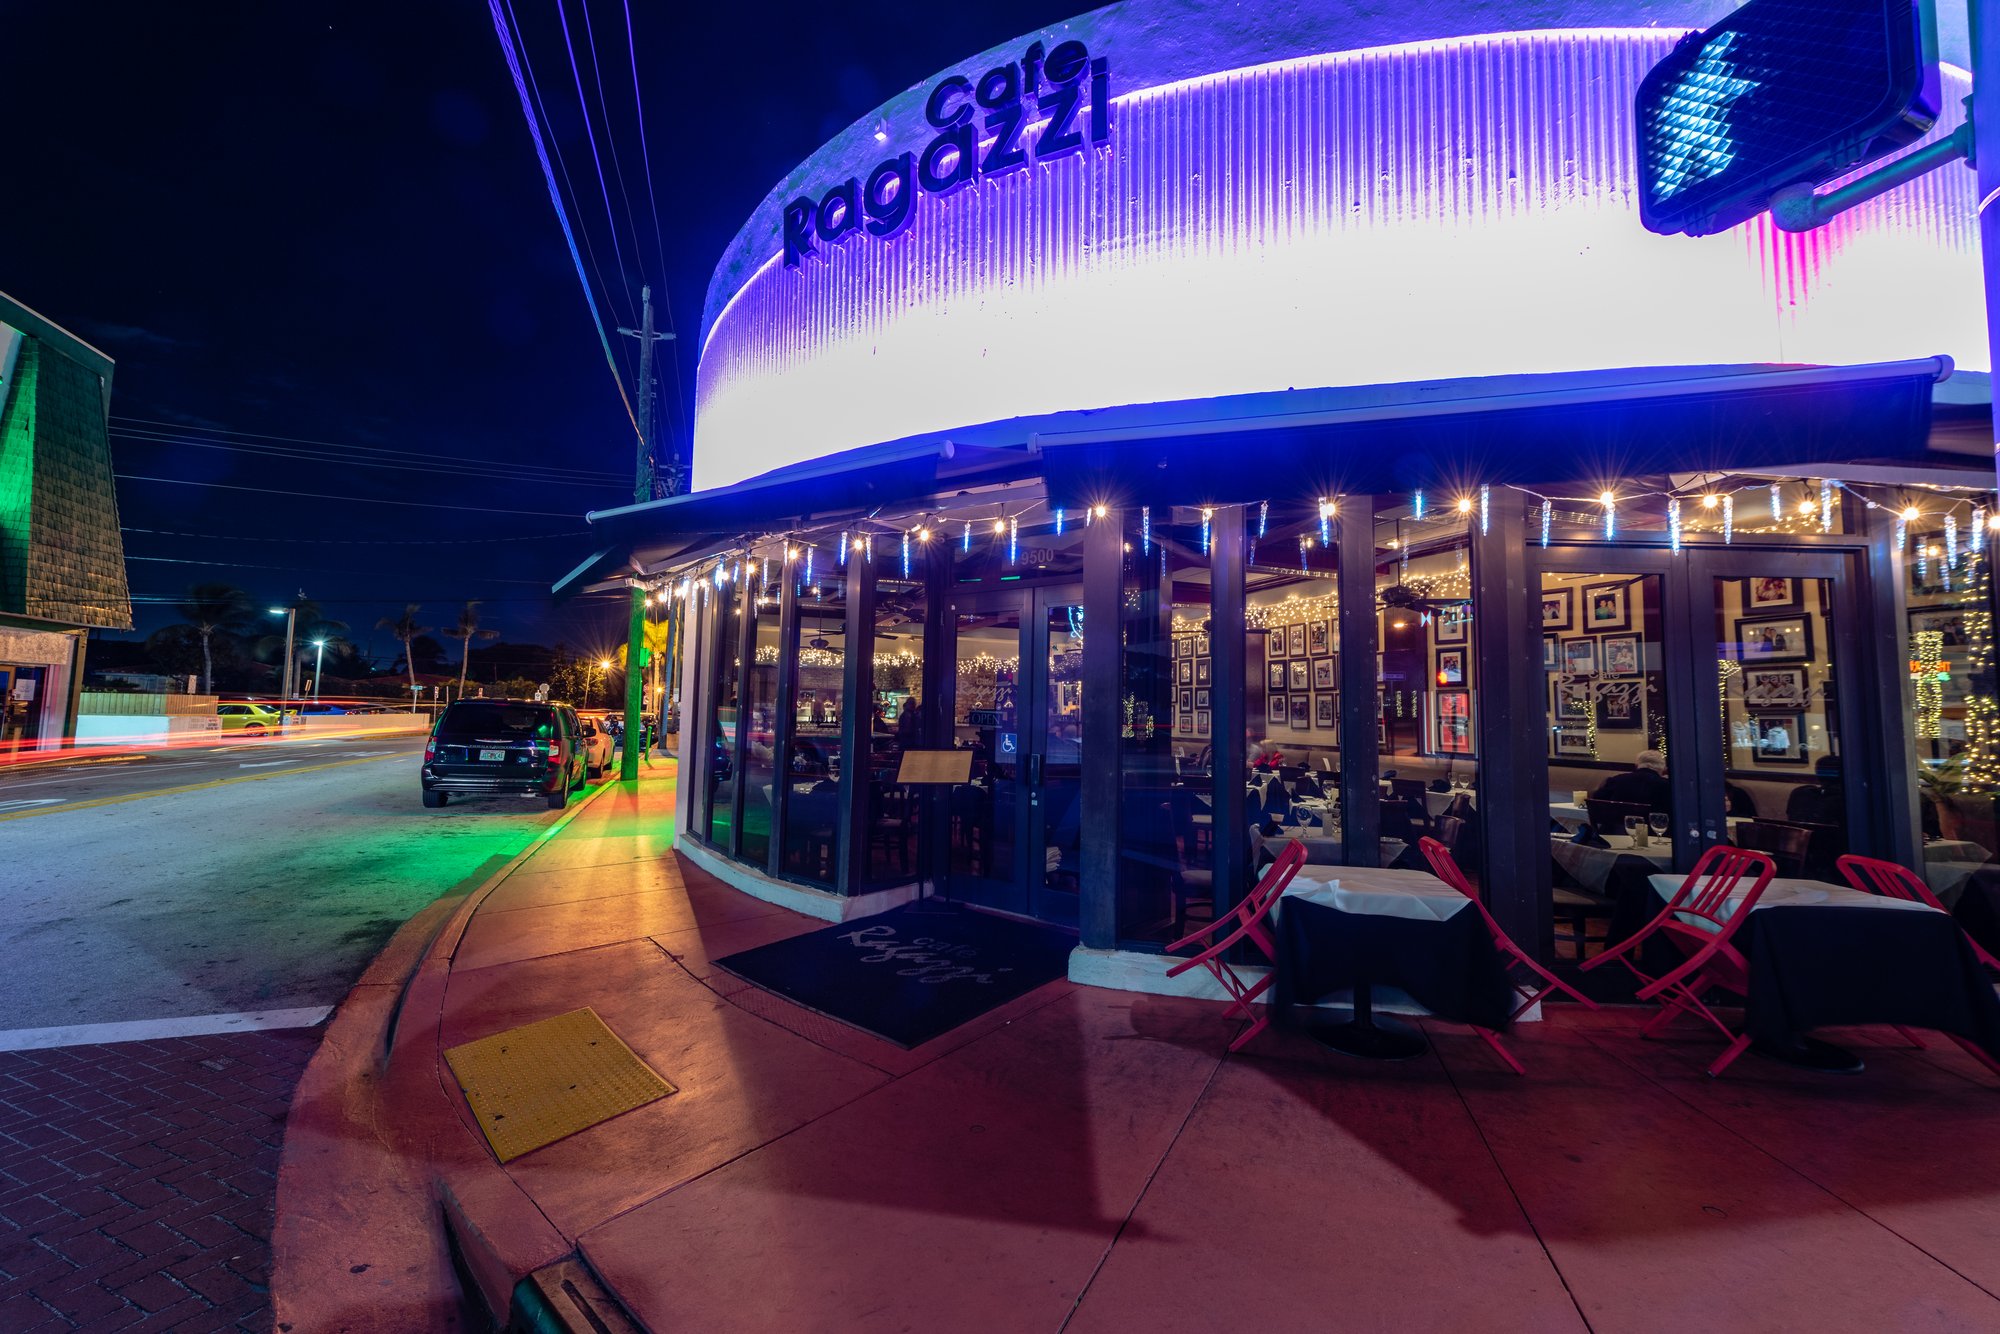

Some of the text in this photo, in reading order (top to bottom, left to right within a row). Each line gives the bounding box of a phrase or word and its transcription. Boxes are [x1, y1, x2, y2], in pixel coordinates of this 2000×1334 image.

[925, 40, 1090, 131] Cafe
[783, 56, 1111, 271] Ragazzi
[1021, 548, 1054, 565] 9500
[1588, 669, 1620, 679] Cafe
[1760, 674, 1791, 684] Cafe
[959, 680, 1012, 702] Ragazzi
[1556, 671, 1658, 705] Ragazzi
[973, 713, 1000, 725] OPEN
